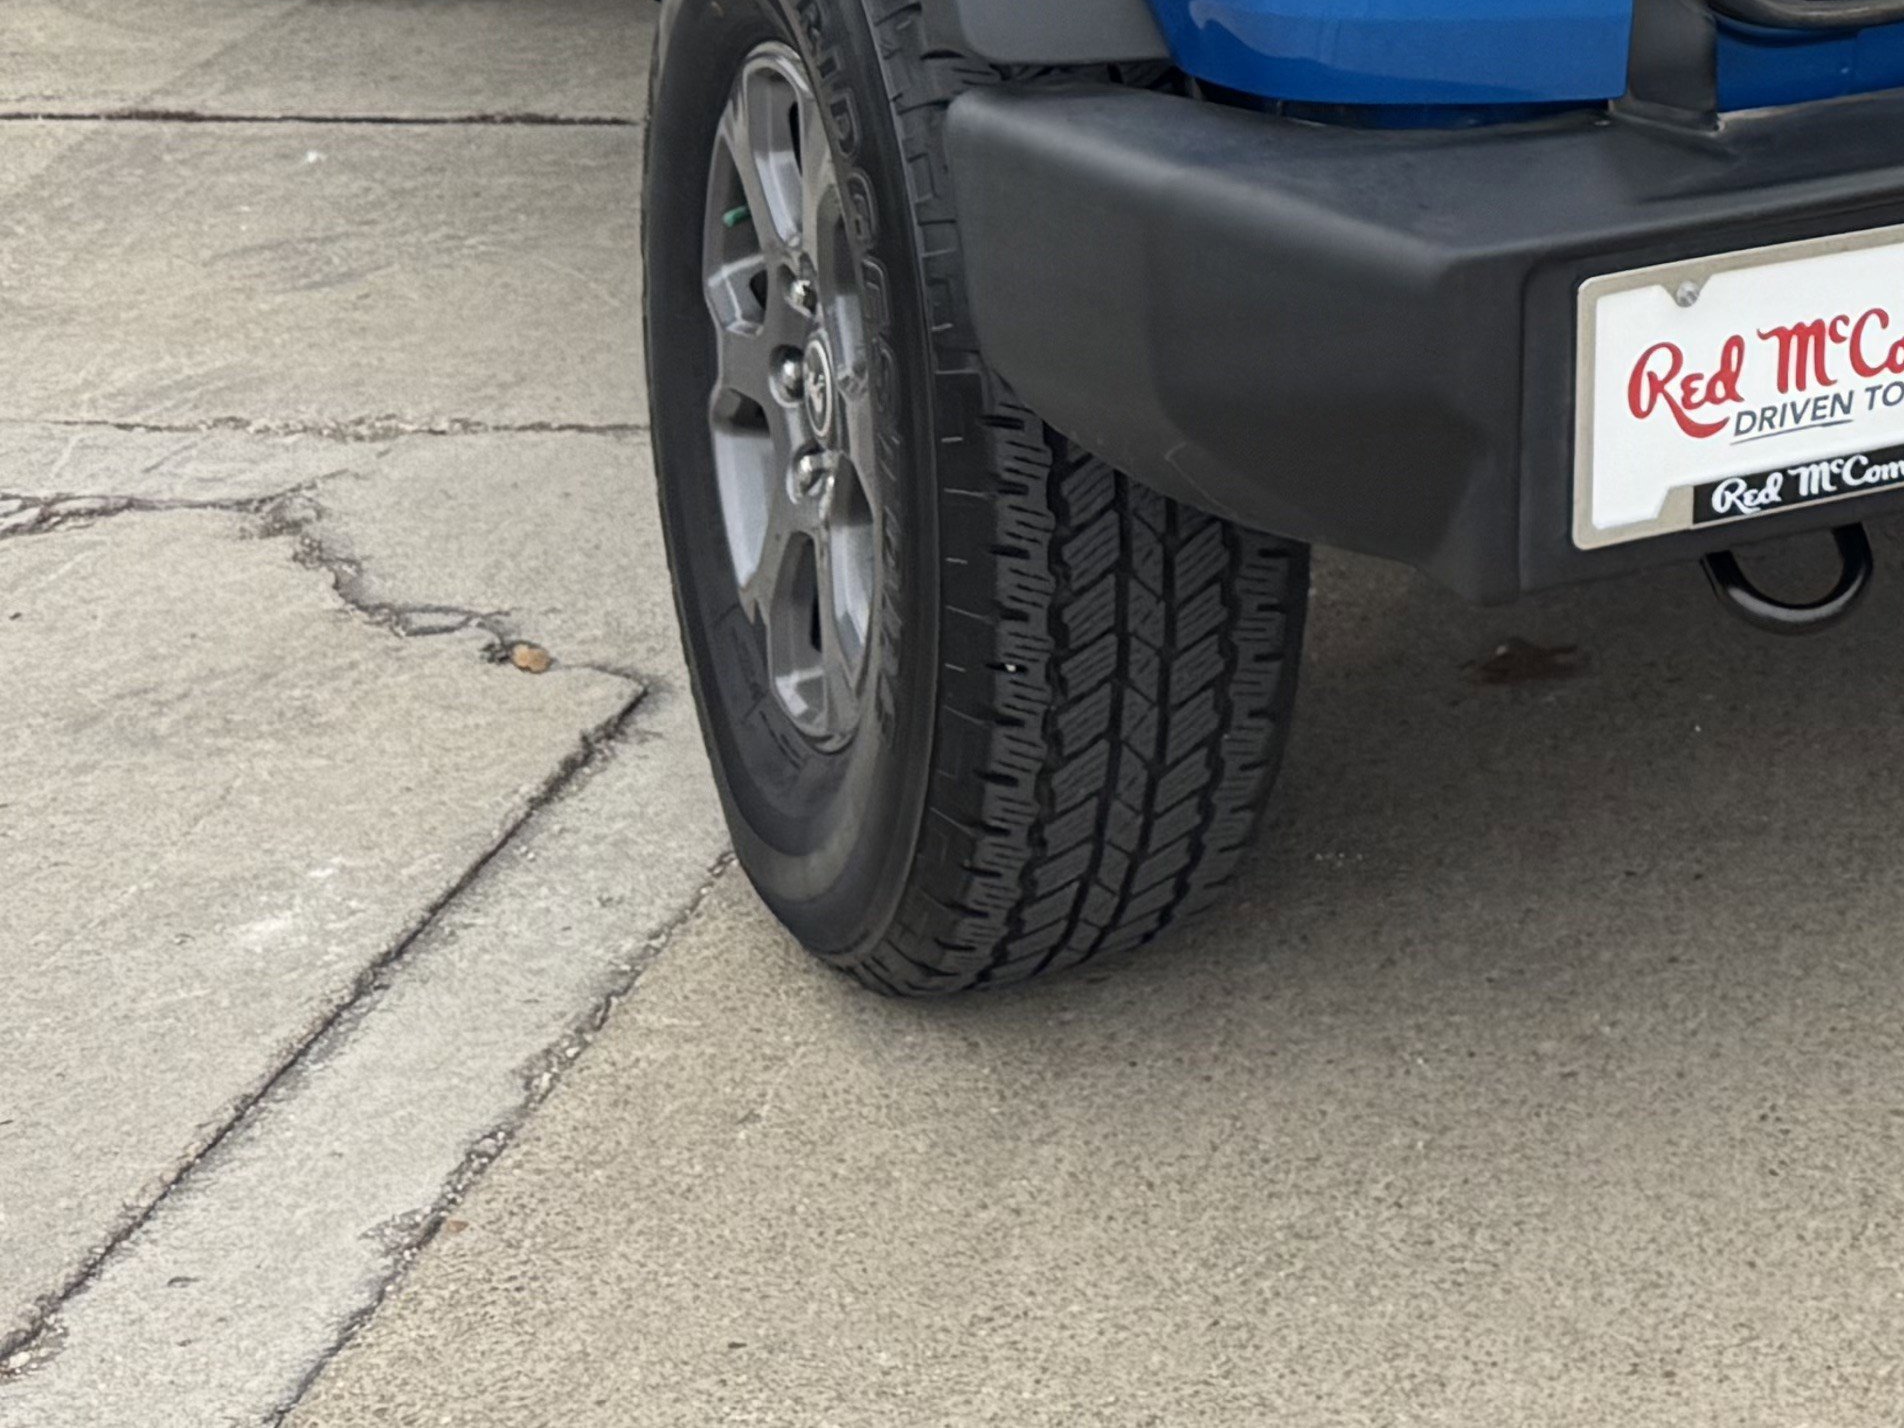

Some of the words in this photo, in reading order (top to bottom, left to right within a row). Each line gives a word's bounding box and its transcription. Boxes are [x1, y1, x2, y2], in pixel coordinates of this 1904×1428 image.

[1627, 335, 1745, 439] Red
[1734, 390, 1854, 437] DRIVEN
[1711, 471, 1784, 515] Red
